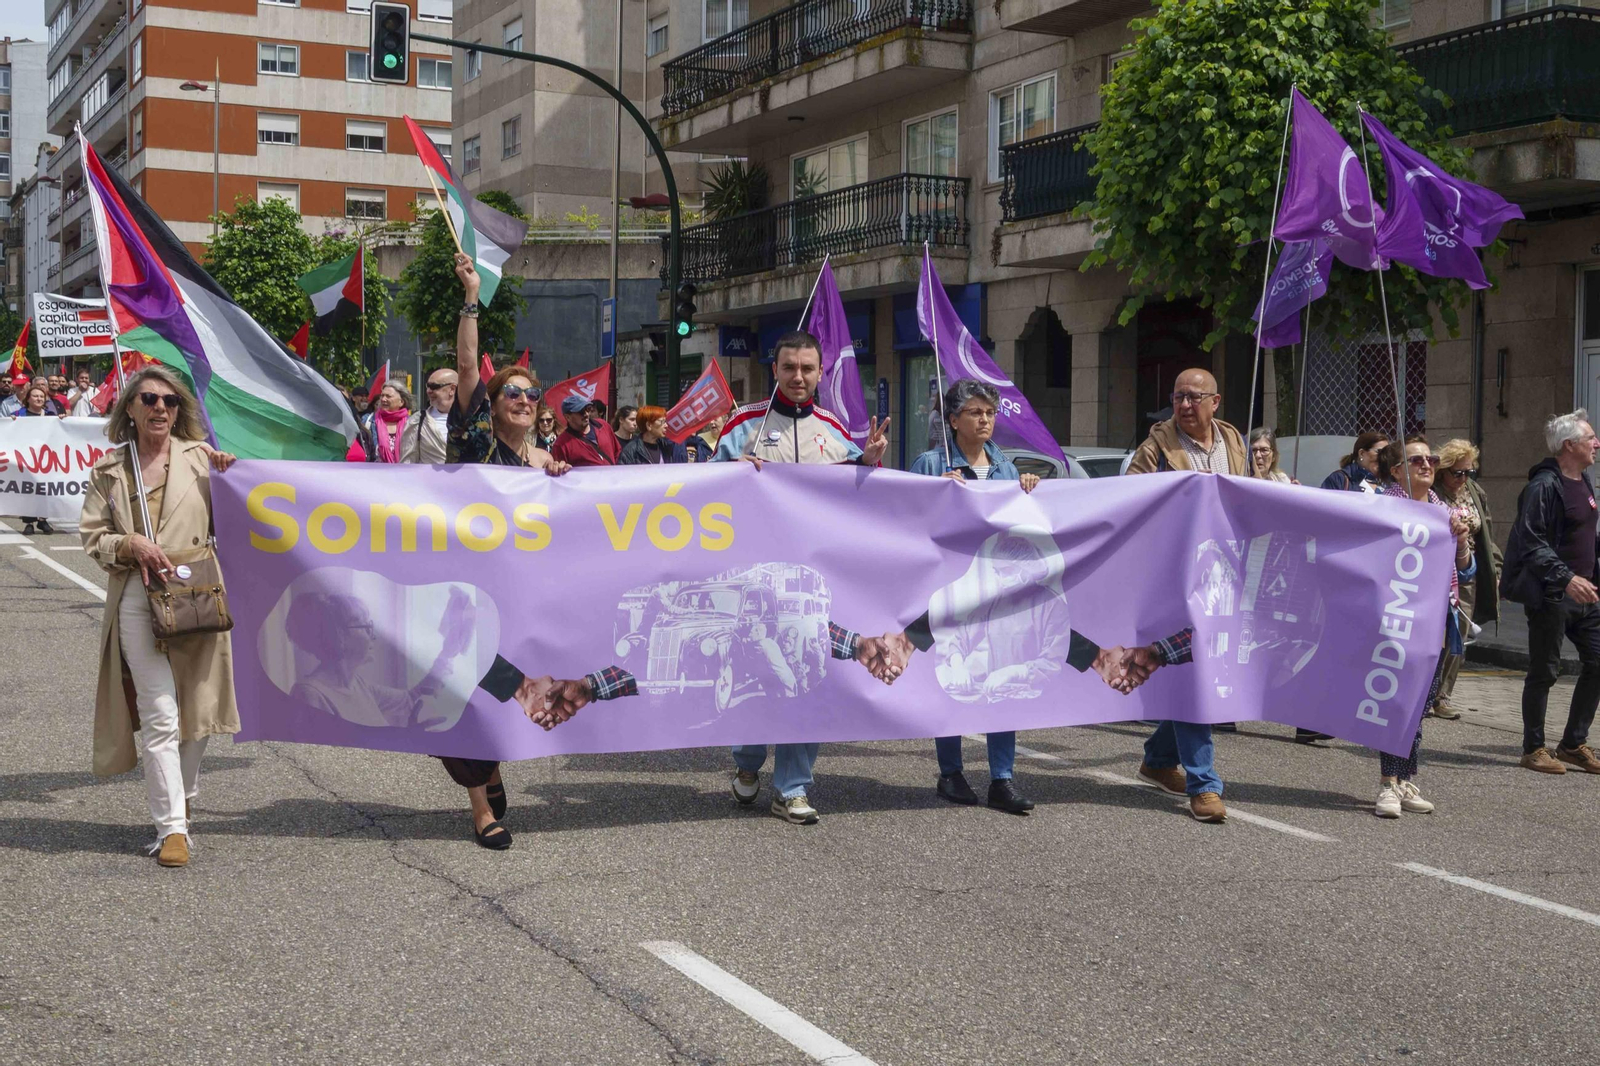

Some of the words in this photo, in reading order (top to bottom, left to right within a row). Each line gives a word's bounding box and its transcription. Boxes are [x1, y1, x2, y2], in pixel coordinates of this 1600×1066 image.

[39, 311, 79, 324] capital
[41, 336, 82, 348] estado
[726, 338, 747, 350] AXA
[14, 443, 70, 474] NON
[246, 482, 552, 554] Somos
[595, 482, 735, 551] vós
[1355, 521, 1430, 727] PODEMOS
